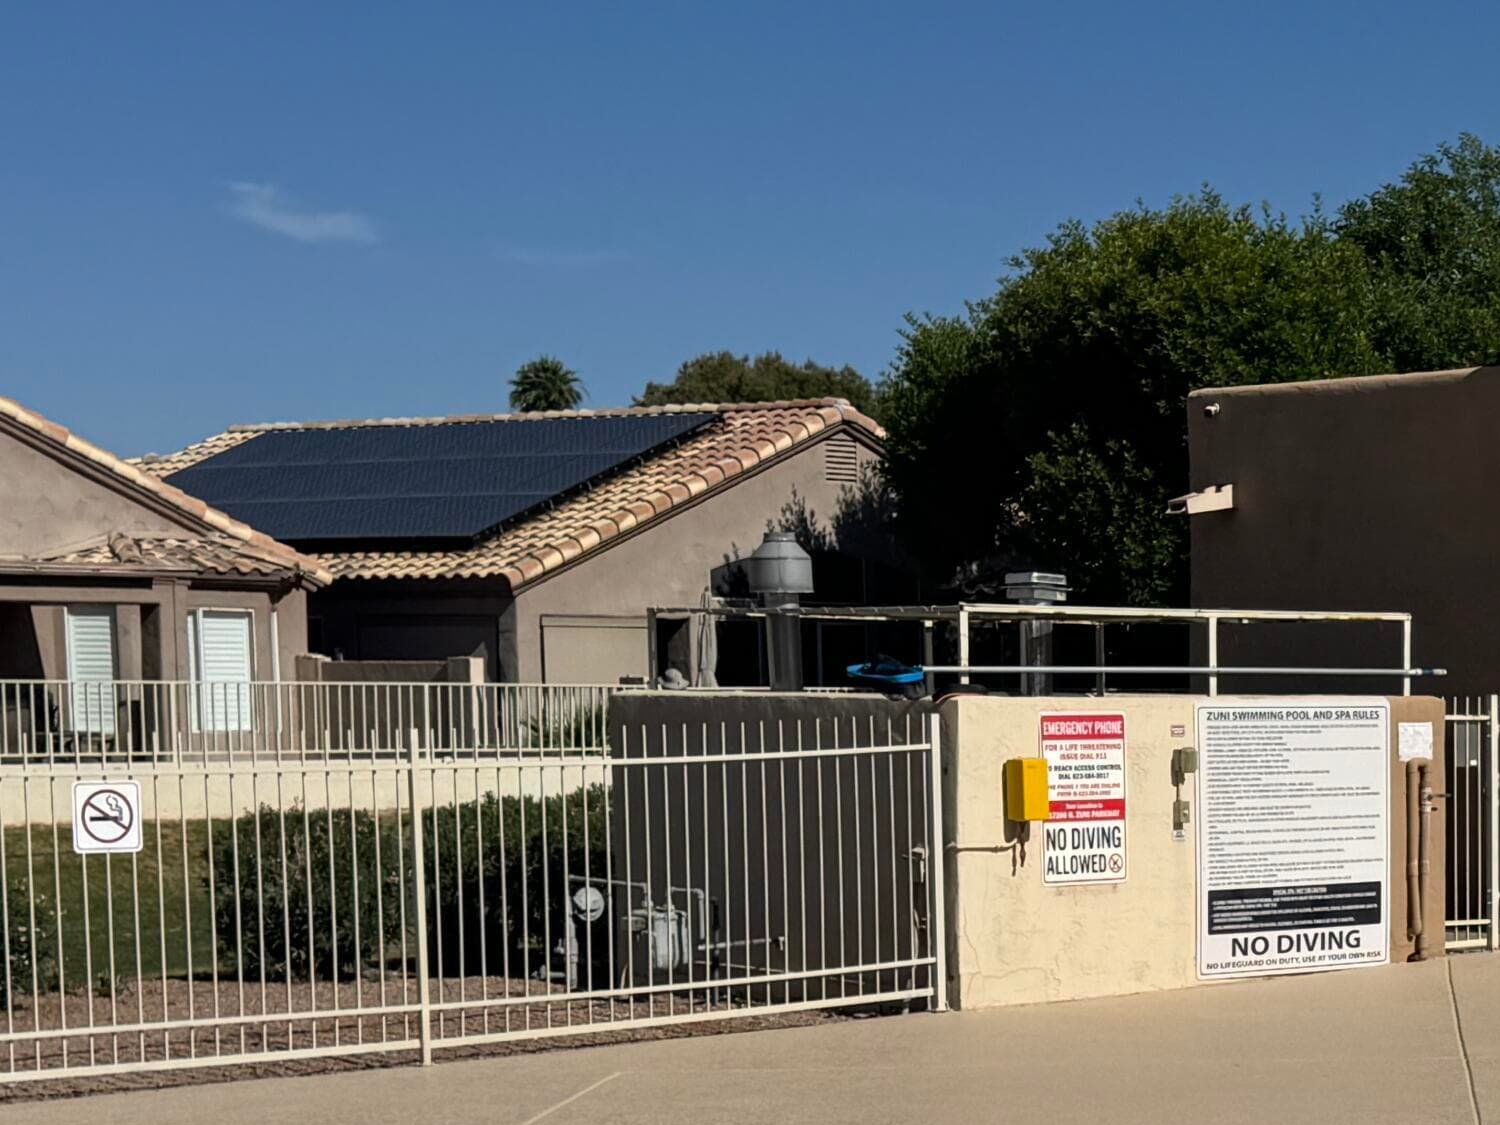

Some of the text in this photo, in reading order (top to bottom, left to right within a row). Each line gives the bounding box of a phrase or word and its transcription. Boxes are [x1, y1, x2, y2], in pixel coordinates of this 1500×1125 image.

[1206, 710, 1380, 721] ZUNI SWIMMING POOL AND SPA RULES
[1043, 720, 1123, 736] EMERGENCY PHONE
[1046, 826, 1121, 851] NO DIVING
[1046, 853, 1107, 875] ALLOWED
[1231, 929, 1361, 958] NO DIVING
[1220, 960, 1264, 970] LIFEGUARD
[1265, 958, 1277, 966] ON
[1279, 956, 1301, 965] DUTY,
[1302, 955, 1316, 963] USE
[1317, 954, 1326, 962] AT
[1328, 953, 1347, 961] YOUR
[1348, 952, 1365, 960] OWN
[1366, 950, 1381, 958] RISK
